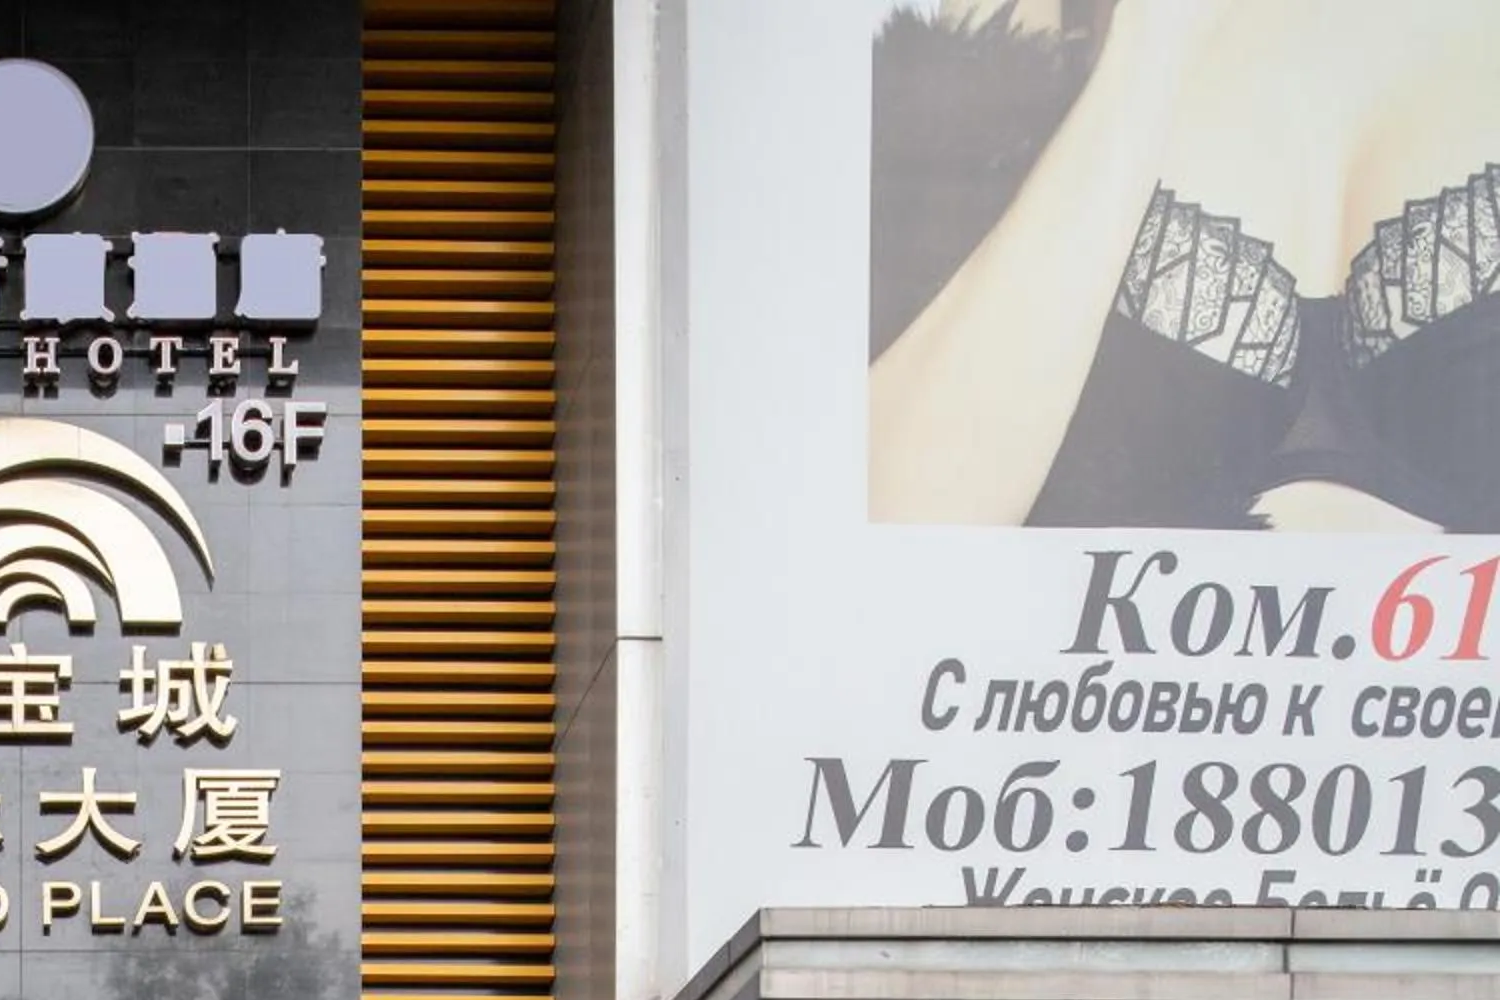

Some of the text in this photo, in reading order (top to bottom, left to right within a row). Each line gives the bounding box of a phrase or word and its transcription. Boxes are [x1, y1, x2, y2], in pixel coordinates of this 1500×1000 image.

[23, 336, 299, 376] HOTEL
[921, 657, 967, 731] С
[973, 659, 1269, 736] любовью
[1350, 685, 1500, 739] свое
[41, 879, 285, 934] PLACE
